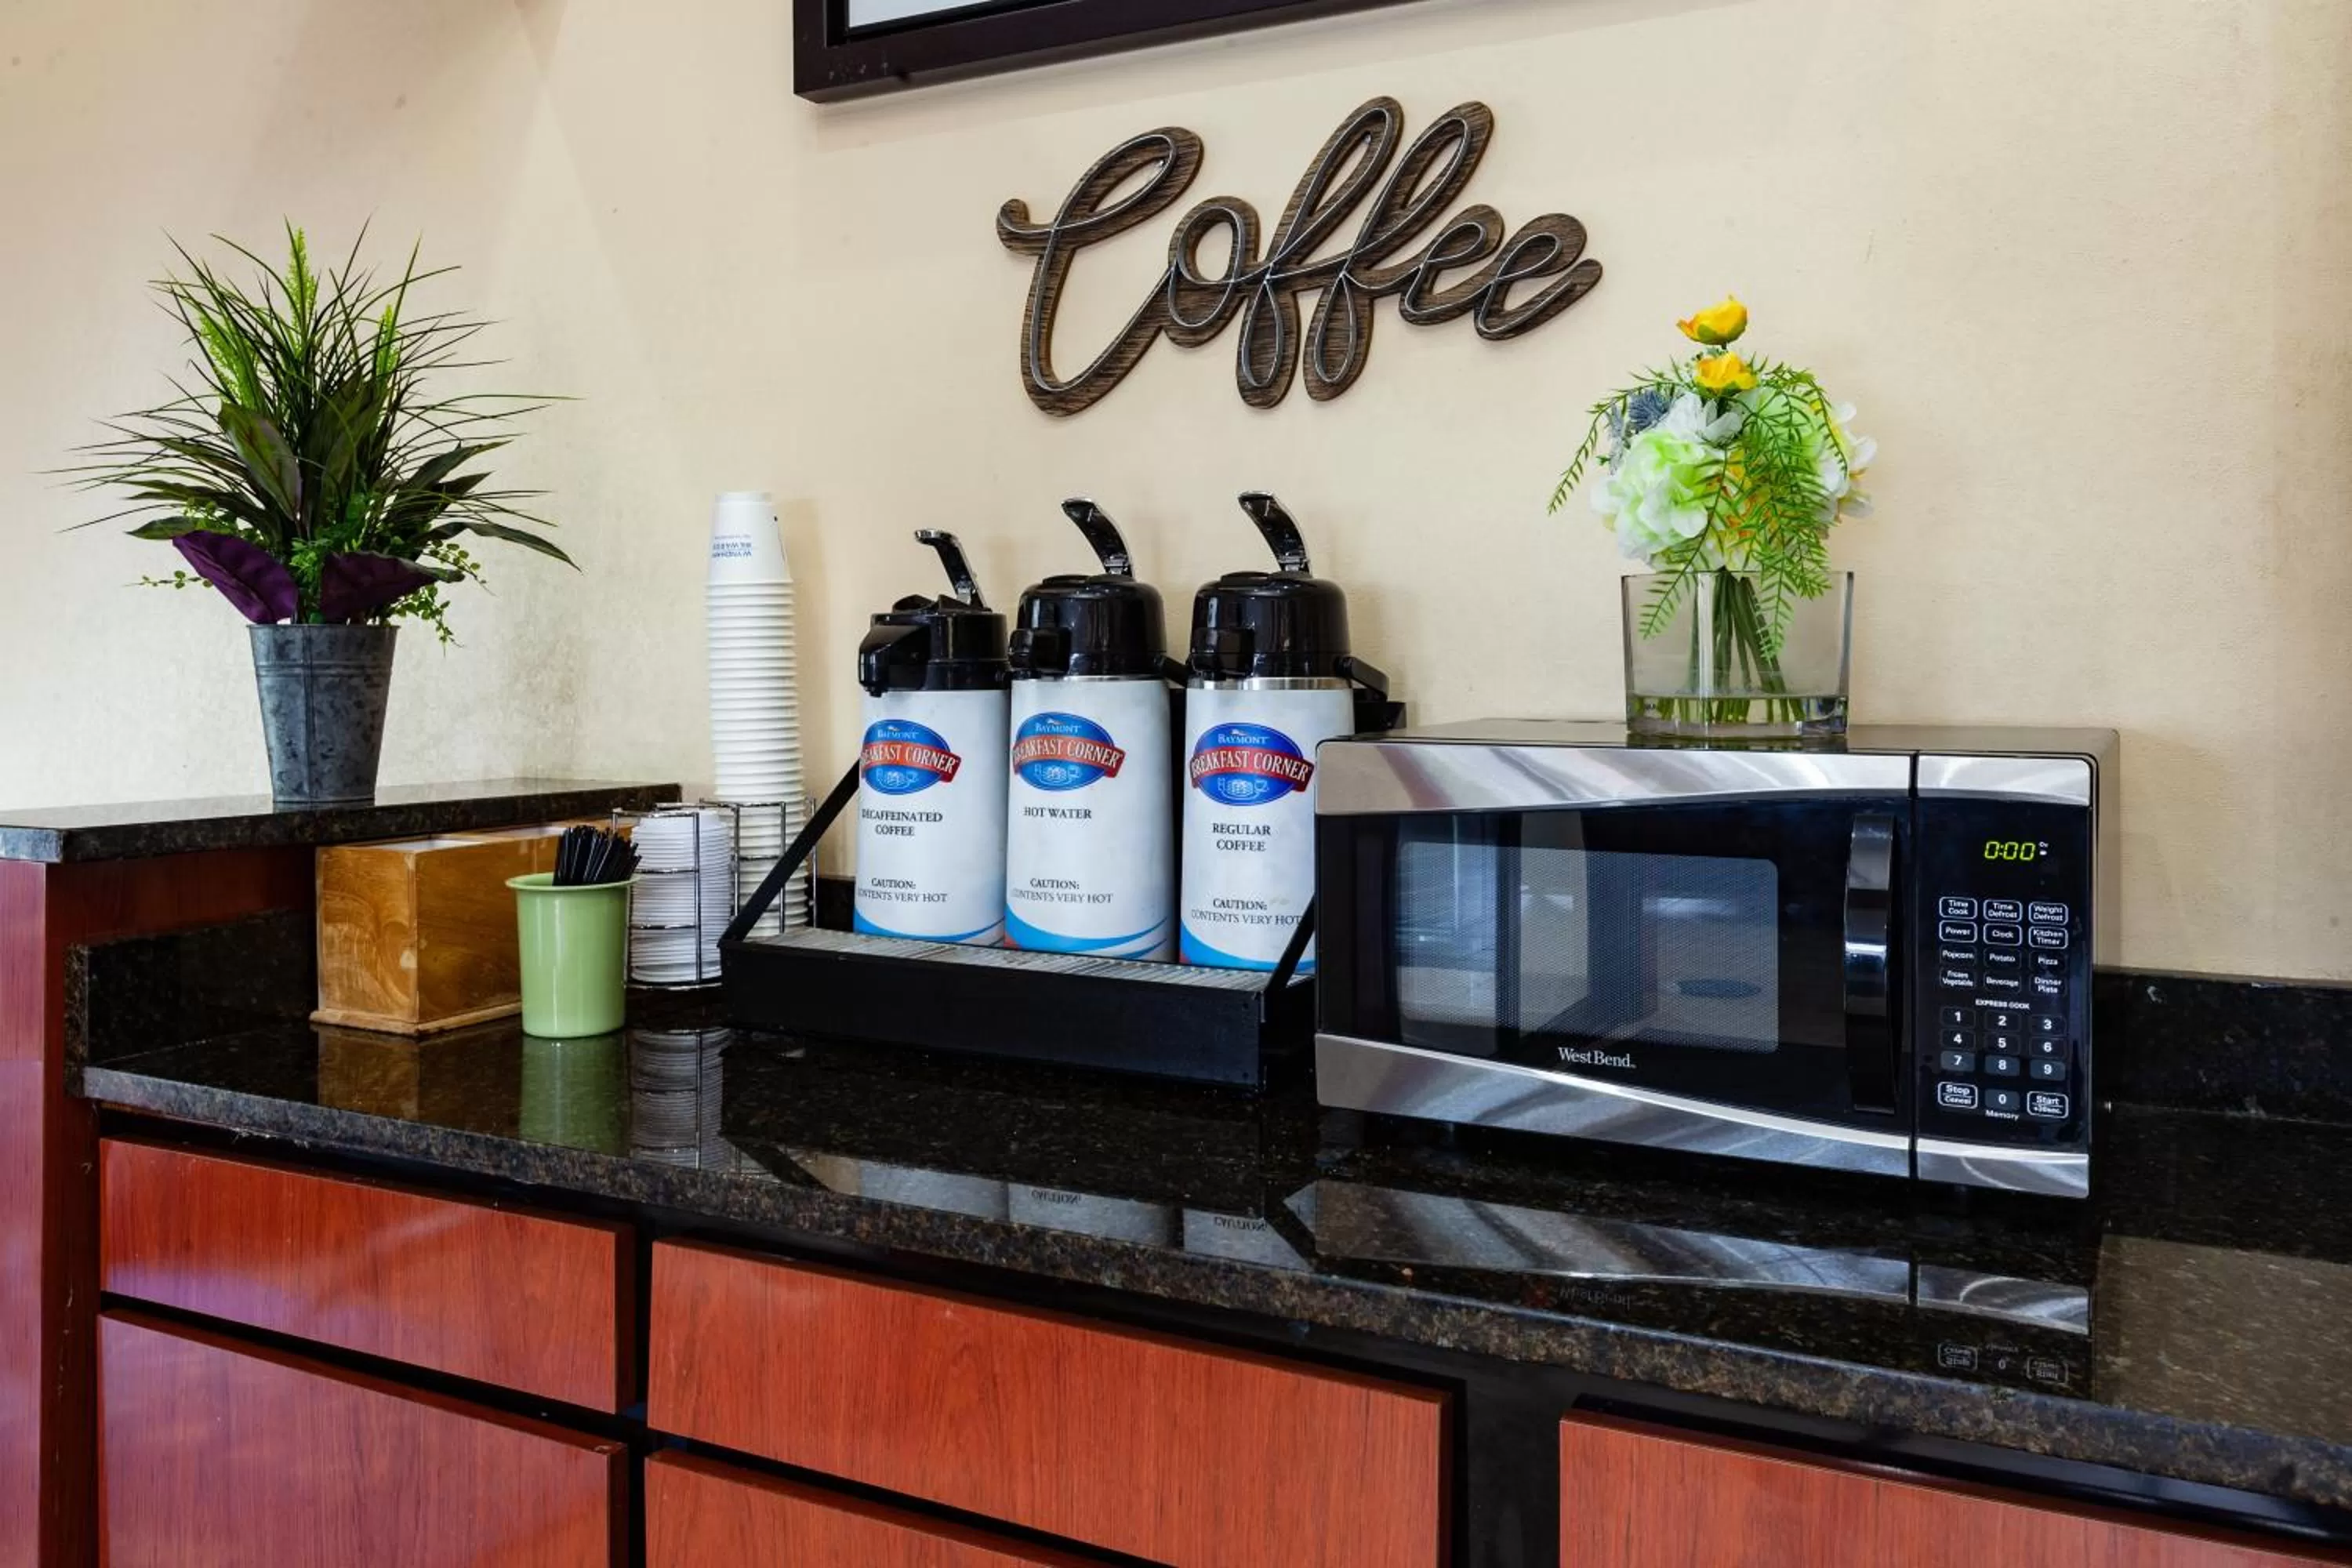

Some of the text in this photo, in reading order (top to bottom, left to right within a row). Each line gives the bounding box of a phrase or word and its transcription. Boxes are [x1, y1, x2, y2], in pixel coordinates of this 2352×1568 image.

[996, 96, 1602, 417] Coffee
[1036, 723, 1081, 734] BAYMONT
[1218, 734, 1270, 745] BAYMONT
[905, 745, 956, 774] CORNER
[1067, 740, 1121, 768] CORNER
[1191, 750, 1309, 782] BREAKFAST CORNER
[1023, 807, 1092, 819] HOT WATER
[875, 825, 915, 837] COFFEE
[1213, 822, 1271, 836] REGULAR
[1216, 839, 1265, 851] COFFEE
[1984, 841, 2036, 860] 0:00
[871, 877, 916, 889] CAUTION:
[1029, 878, 1080, 889] CAUTION:
[894, 892, 919, 902] VERY
[923, 893, 947, 902] HOT
[1056, 892, 1084, 902] VERY
[1087, 893, 1113, 904] HOT
[1213, 898, 1268, 910] CAUTION:
[2034, 905, 2063, 914] Weight
[1191, 909, 1301, 925] CONTENTS VERY HOT
[2033, 913, 2063, 921] Defrost
[1945, 927, 1971, 935] Power
[1991, 929, 2014, 938] Clock
[2033, 929, 2063, 938] Kitchen
[1942, 949, 1974, 960] Popcorn
[1989, 953, 2016, 962] Potato
[2038, 956, 2058, 965] Pizza
[1986, 977, 2019, 987] Beverage
[2034, 977, 2062, 985] Dinner
[1975, 998, 2030, 1010] EXPRESS COOK
[1955, 1011, 1962, 1022] 1
[1998, 1015, 2006, 1026] 2
[2043, 1018, 2052, 1029] 3
[1953, 1033, 1962, 1044] 4
[1998, 1037, 2006, 1048] 5
[2043, 1042, 2053, 1052] 6
[1558, 1047, 1631, 1067] West Bend
[1954, 1054, 1962, 1065] 7
[1998, 1059, 2006, 1070] 8
[2043, 1064, 2052, 1075] 9
[1945, 1084, 1969, 1095] Stop
[1998, 1094, 2007, 1105] 0
[2036, 1095, 2060, 1105] Start
[1985, 1109, 2020, 1120] Memory
